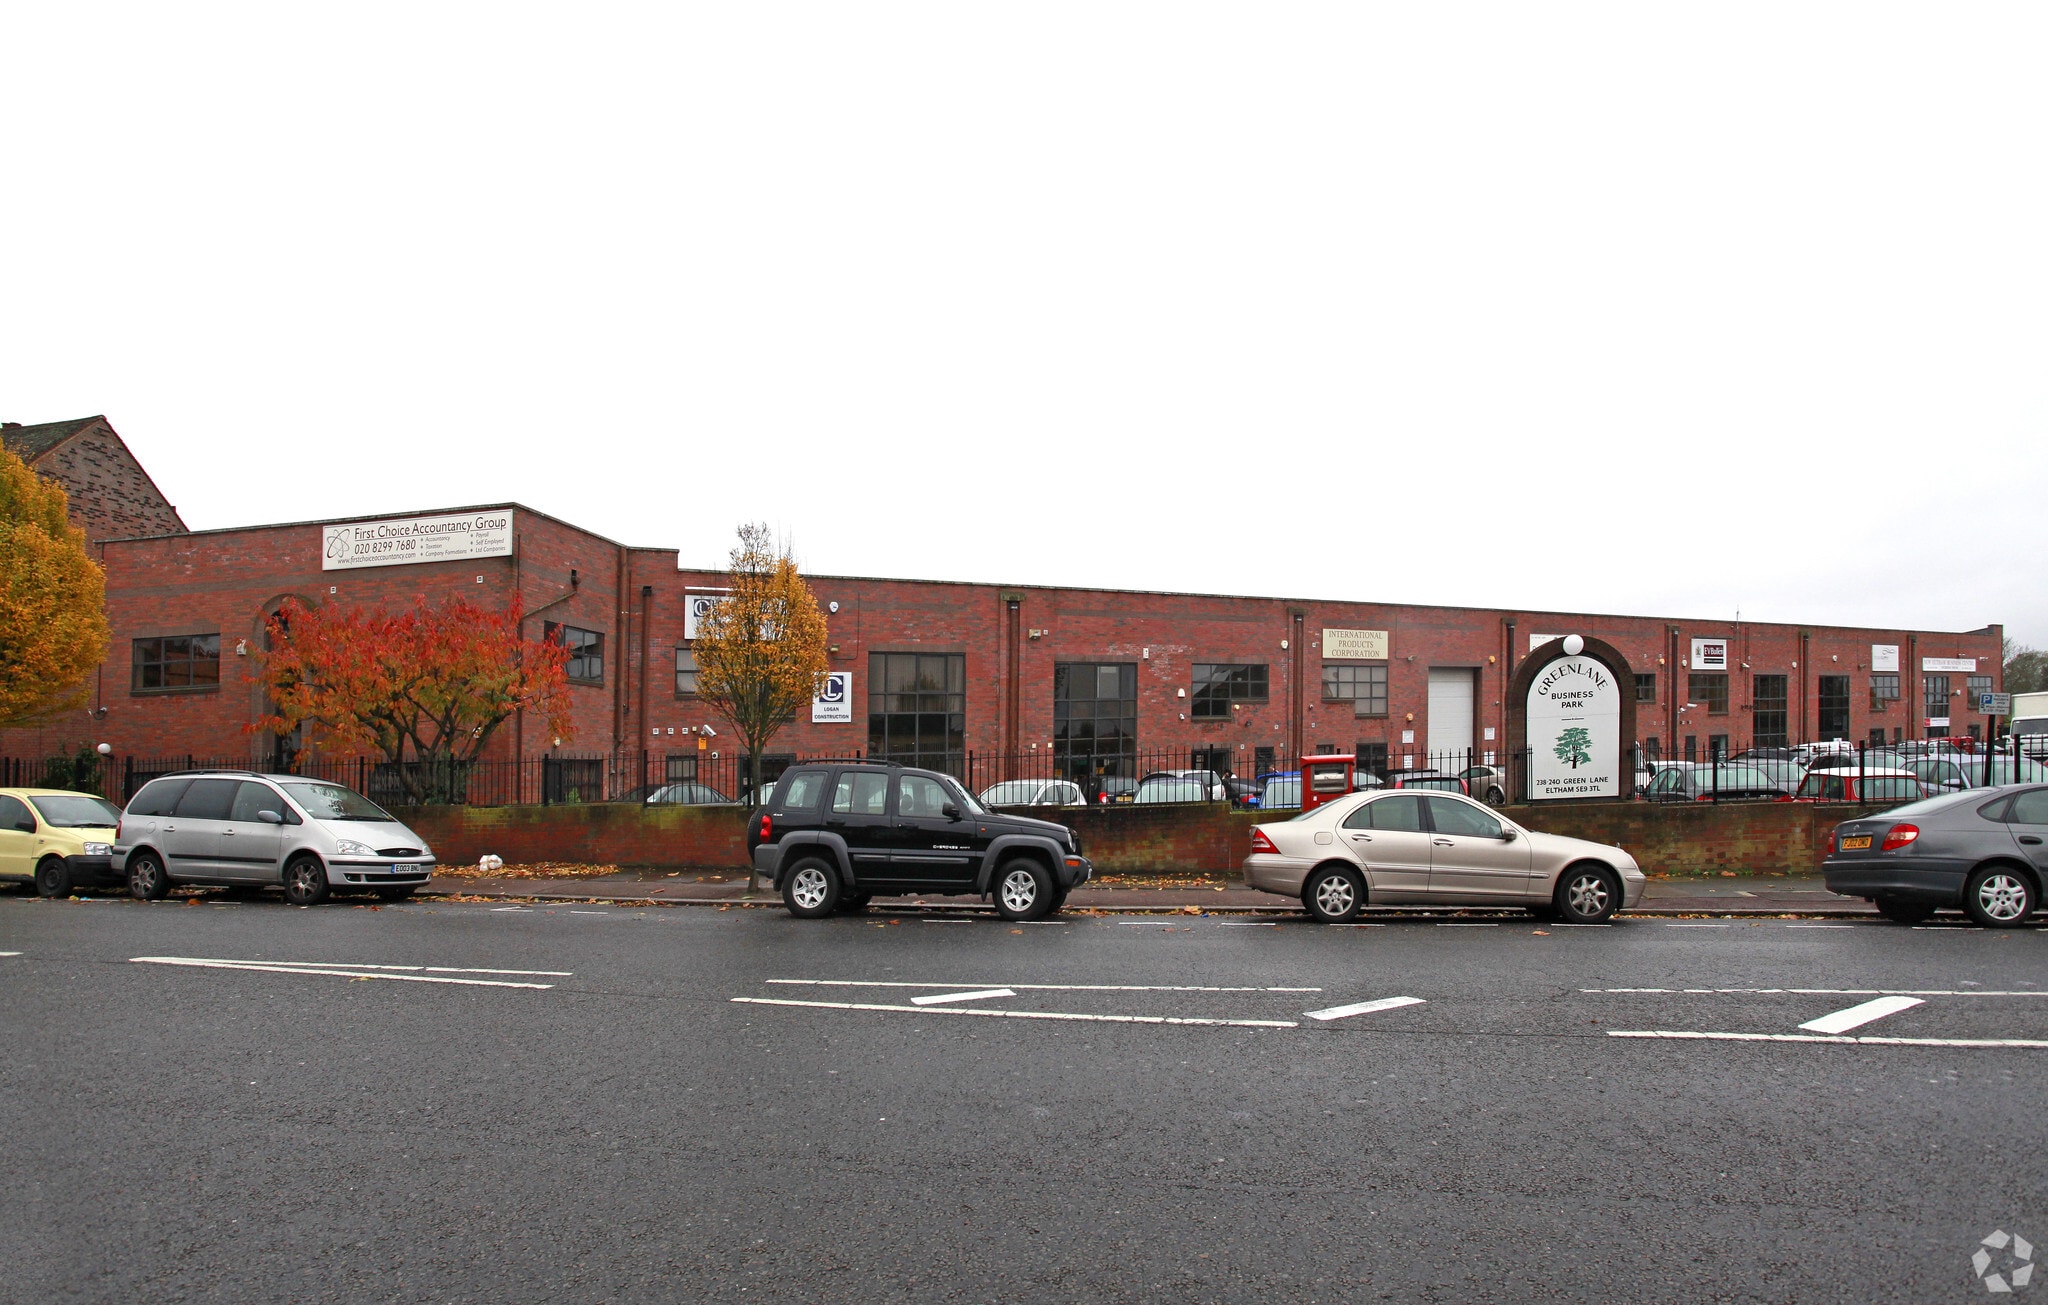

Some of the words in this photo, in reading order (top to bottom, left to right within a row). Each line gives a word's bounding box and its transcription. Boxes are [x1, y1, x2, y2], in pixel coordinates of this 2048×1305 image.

[354, 527, 375, 540] First
[377, 525, 410, 538] Choice
[412, 521, 472, 534] Accountancy
[475, 516, 507, 531] Group
[354, 543, 370, 555] 020
[372, 541, 393, 553] 8299
[396, 539, 416, 551] 7680
[338, 552, 416, 564] www.firstchoiceaccountancy.com
[1328, 630, 1383, 639] INTERNATIONAL
[1338, 640, 1374, 648] PRODUCTS
[1331, 649, 1380, 658] CORPORATION
[1537, 663, 1609, 695] GREENLANE
[1551, 691, 1594, 700] BUSINESS
[1563, 777, 1587, 785] GREEN
[1589, 776, 1609, 784] LANE
[1545, 786, 1574, 794] ELTHAM
